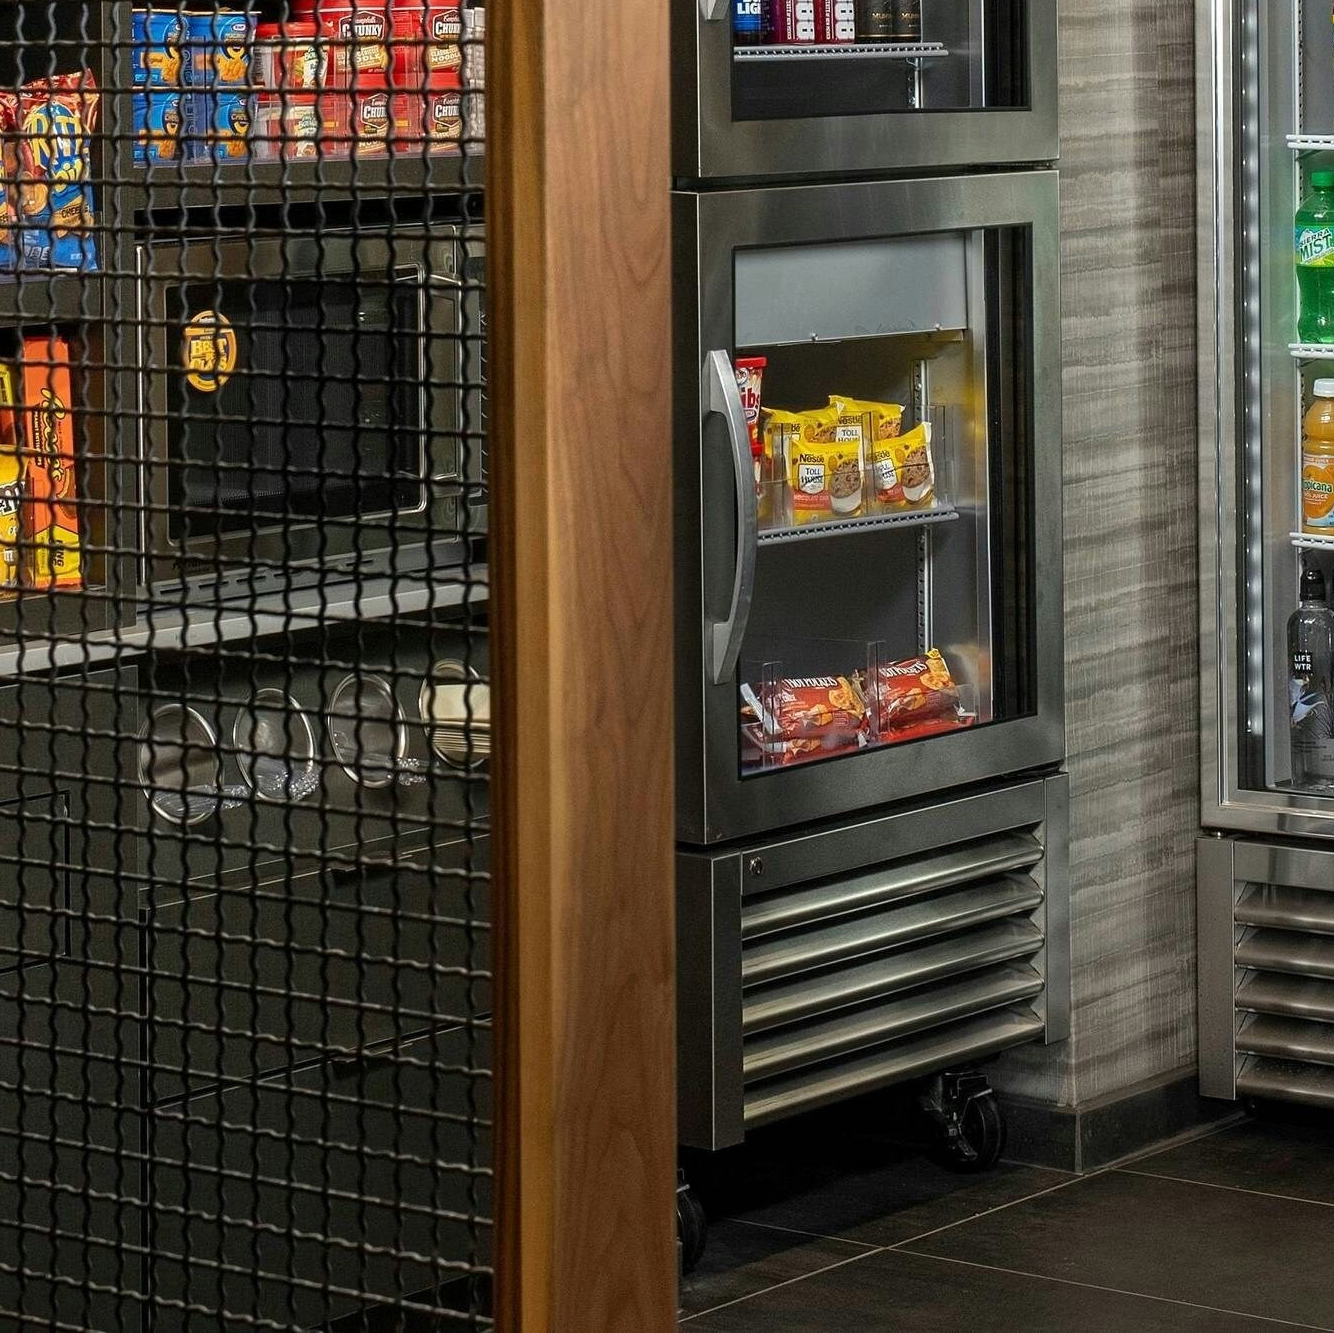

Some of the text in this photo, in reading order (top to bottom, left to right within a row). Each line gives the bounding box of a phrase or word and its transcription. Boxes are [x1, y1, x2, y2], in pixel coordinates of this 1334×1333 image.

[736, 2, 761, 15] LIG
[341, 22, 383, 38] CUNKY
[431, 52, 461, 63] NOODL
[1300, 227, 1330, 247] SIERRA
[1299, 235, 1334, 258] MIST
[841, 429, 859, 437] TOLL
[806, 467, 820, 476] TOLL
[1294, 655, 1312, 664] LIFE
[1294, 663, 1312, 672] WTR
